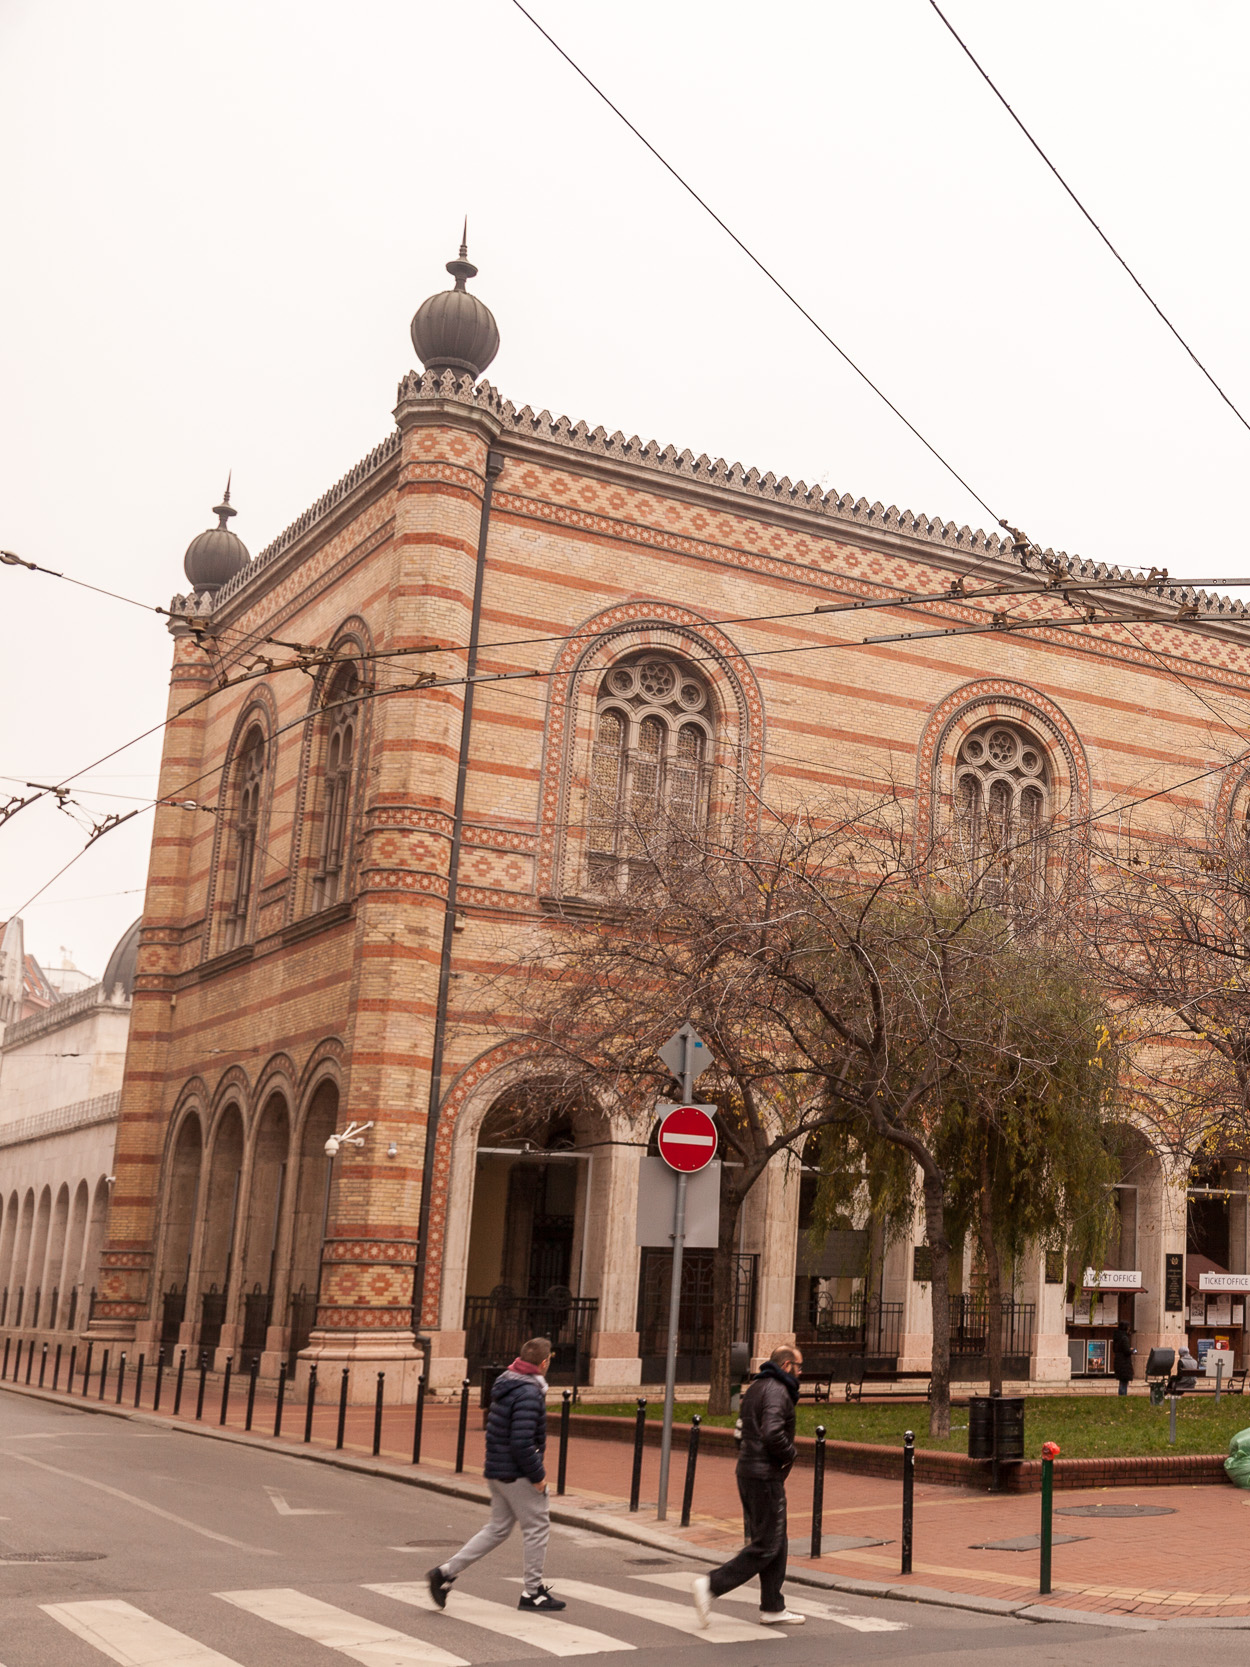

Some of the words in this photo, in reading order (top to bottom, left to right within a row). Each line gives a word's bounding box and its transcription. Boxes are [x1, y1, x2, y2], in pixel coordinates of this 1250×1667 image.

[1089, 1273, 1112, 1282] TKET
[1113, 1274, 1137, 1283] OFFICE
[1204, 1277, 1225, 1285] TICKET
[1226, 1277, 1249, 1286] OFFICE
